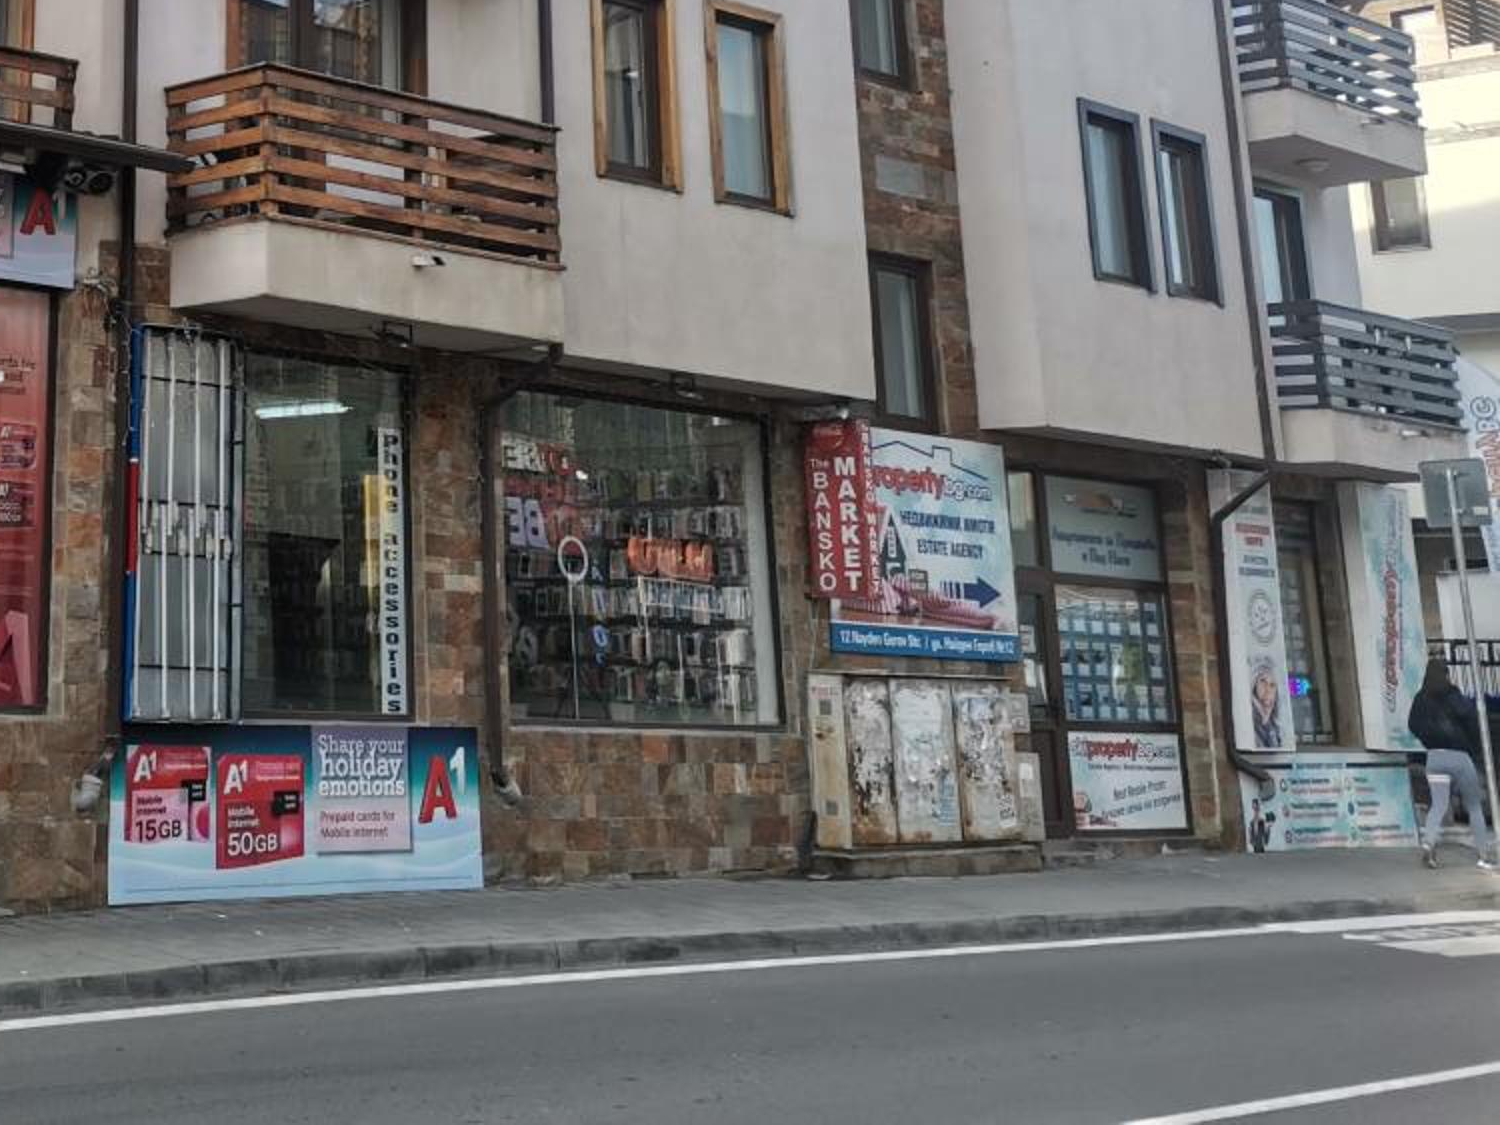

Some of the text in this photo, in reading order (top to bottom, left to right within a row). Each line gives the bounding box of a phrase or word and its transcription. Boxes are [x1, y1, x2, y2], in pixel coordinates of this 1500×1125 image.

[19, 186, 67, 236] A1
[810, 458, 829, 469] The
[812, 471, 837, 592] BANSKO
[833, 456, 863, 592] MARKET
[917, 539, 949, 556] ESTATE
[383, 434, 401, 713] Phone accessories
[317, 734, 405, 755] Share your
[133, 751, 157, 783] A1
[223, 759, 248, 795] A1
[319, 749, 403, 781] holiday
[318, 776, 405, 796] emotions
[418, 746, 466, 824] A1
[320, 810, 395, 823] Prepaid cards for
[135, 820, 182, 843] 15GB
[227, 832, 279, 856] 50GB
[320, 827, 350, 838] Mobile
